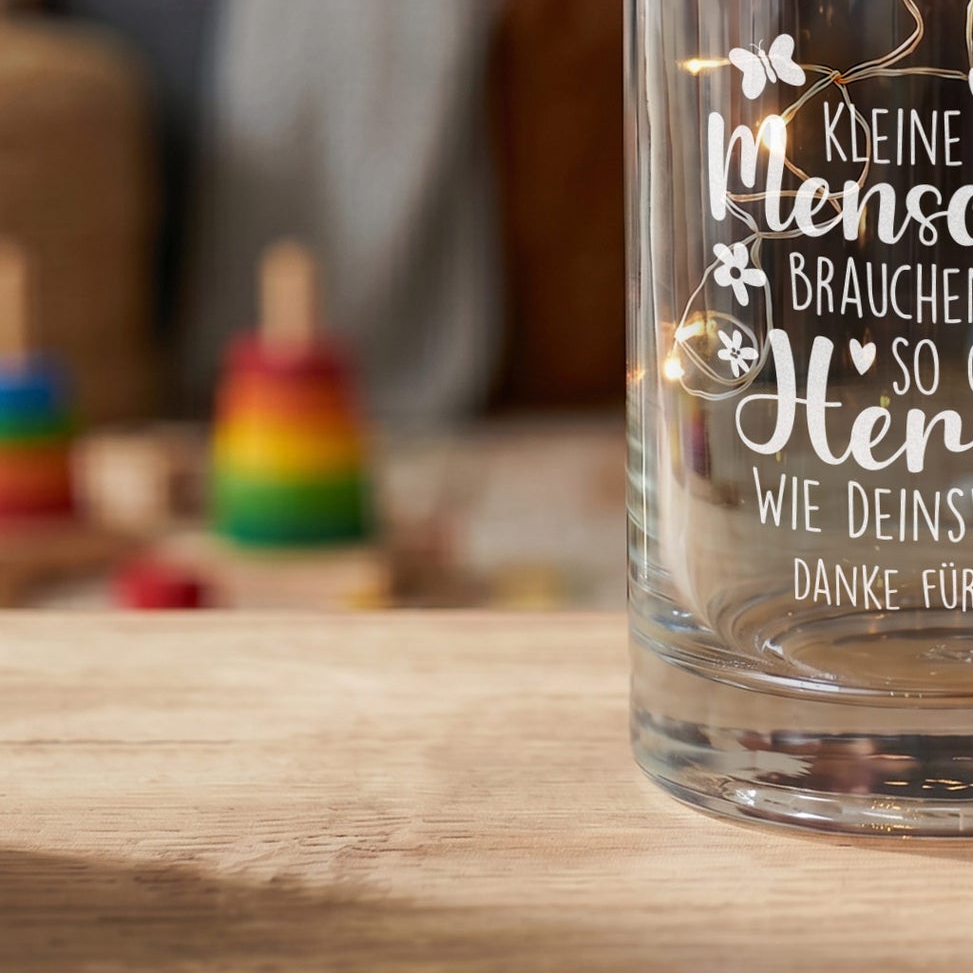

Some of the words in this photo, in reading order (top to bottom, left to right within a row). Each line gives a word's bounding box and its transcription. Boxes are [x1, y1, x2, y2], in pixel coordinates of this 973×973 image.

[823, 101, 963, 167] KLEINE
[892, 336, 939, 396] SO
[753, 467, 821, 533] WIE
[794, 557, 900, 611] DANKE
